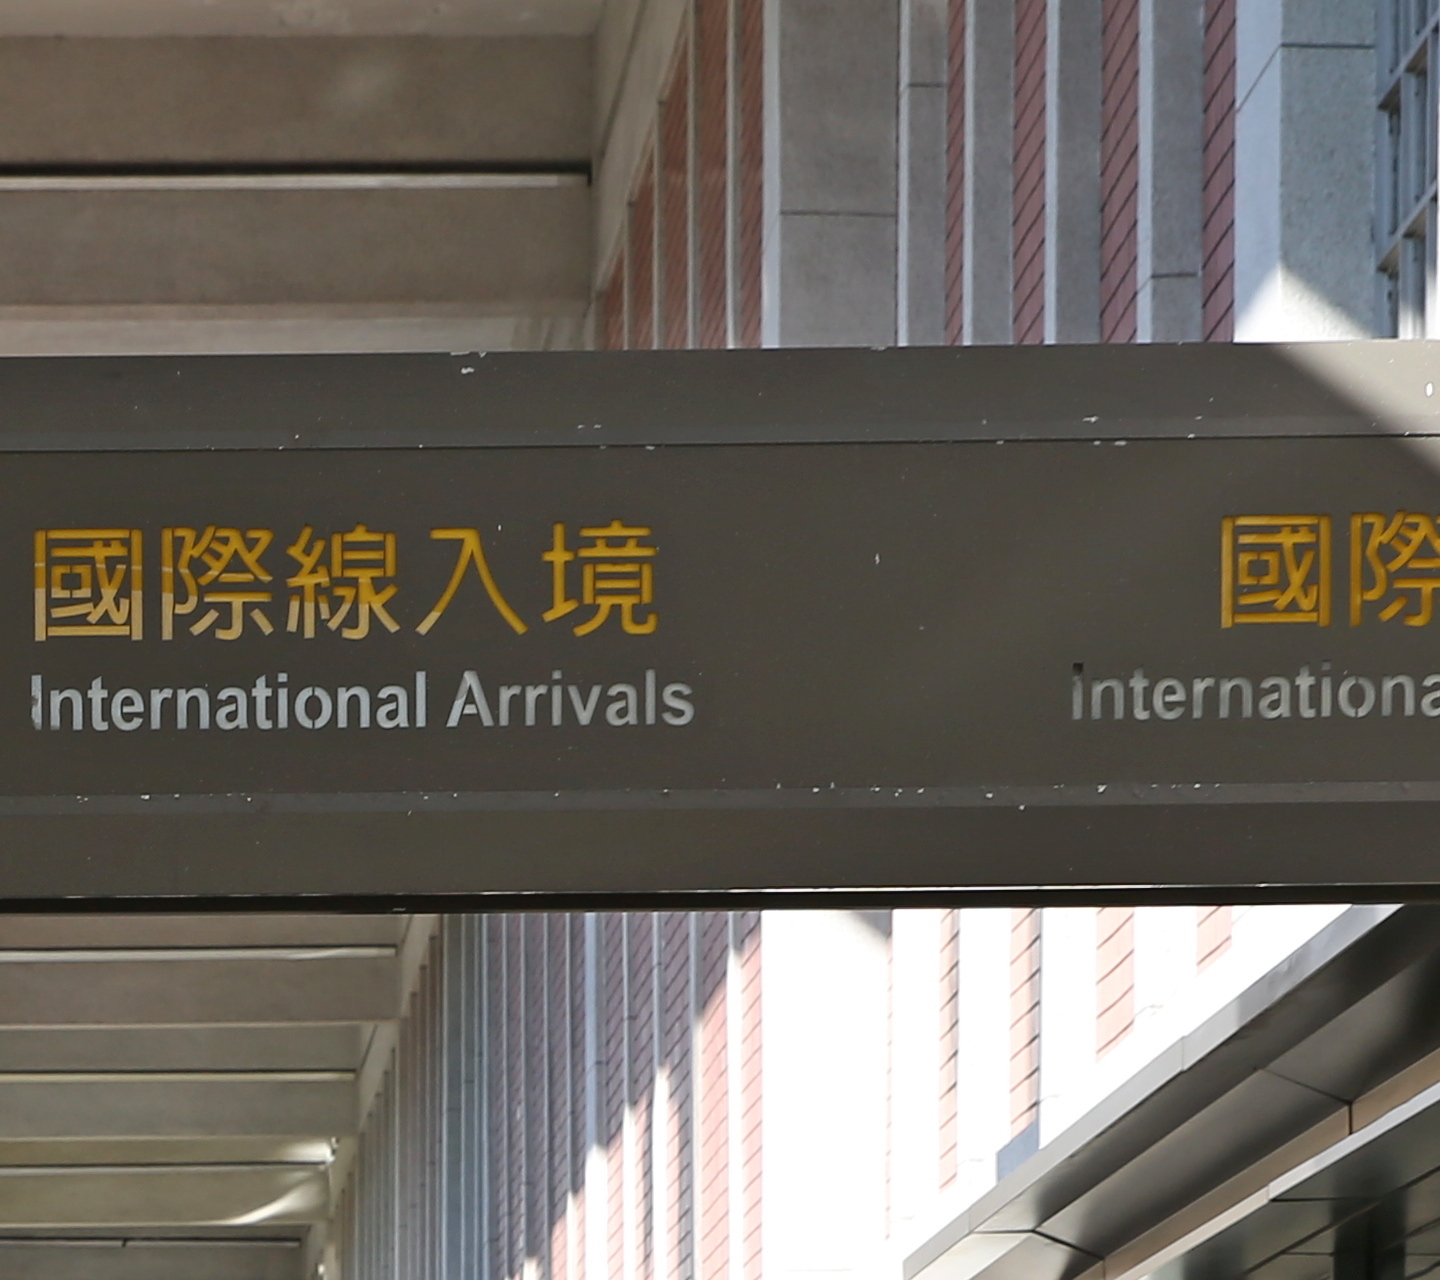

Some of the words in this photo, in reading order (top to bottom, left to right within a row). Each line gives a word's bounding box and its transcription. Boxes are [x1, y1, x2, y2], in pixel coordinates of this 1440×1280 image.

[32, 521, 661, 642] 國際線入境
[29, 671, 428, 733] International
[446, 668, 697, 729] Arrivals
